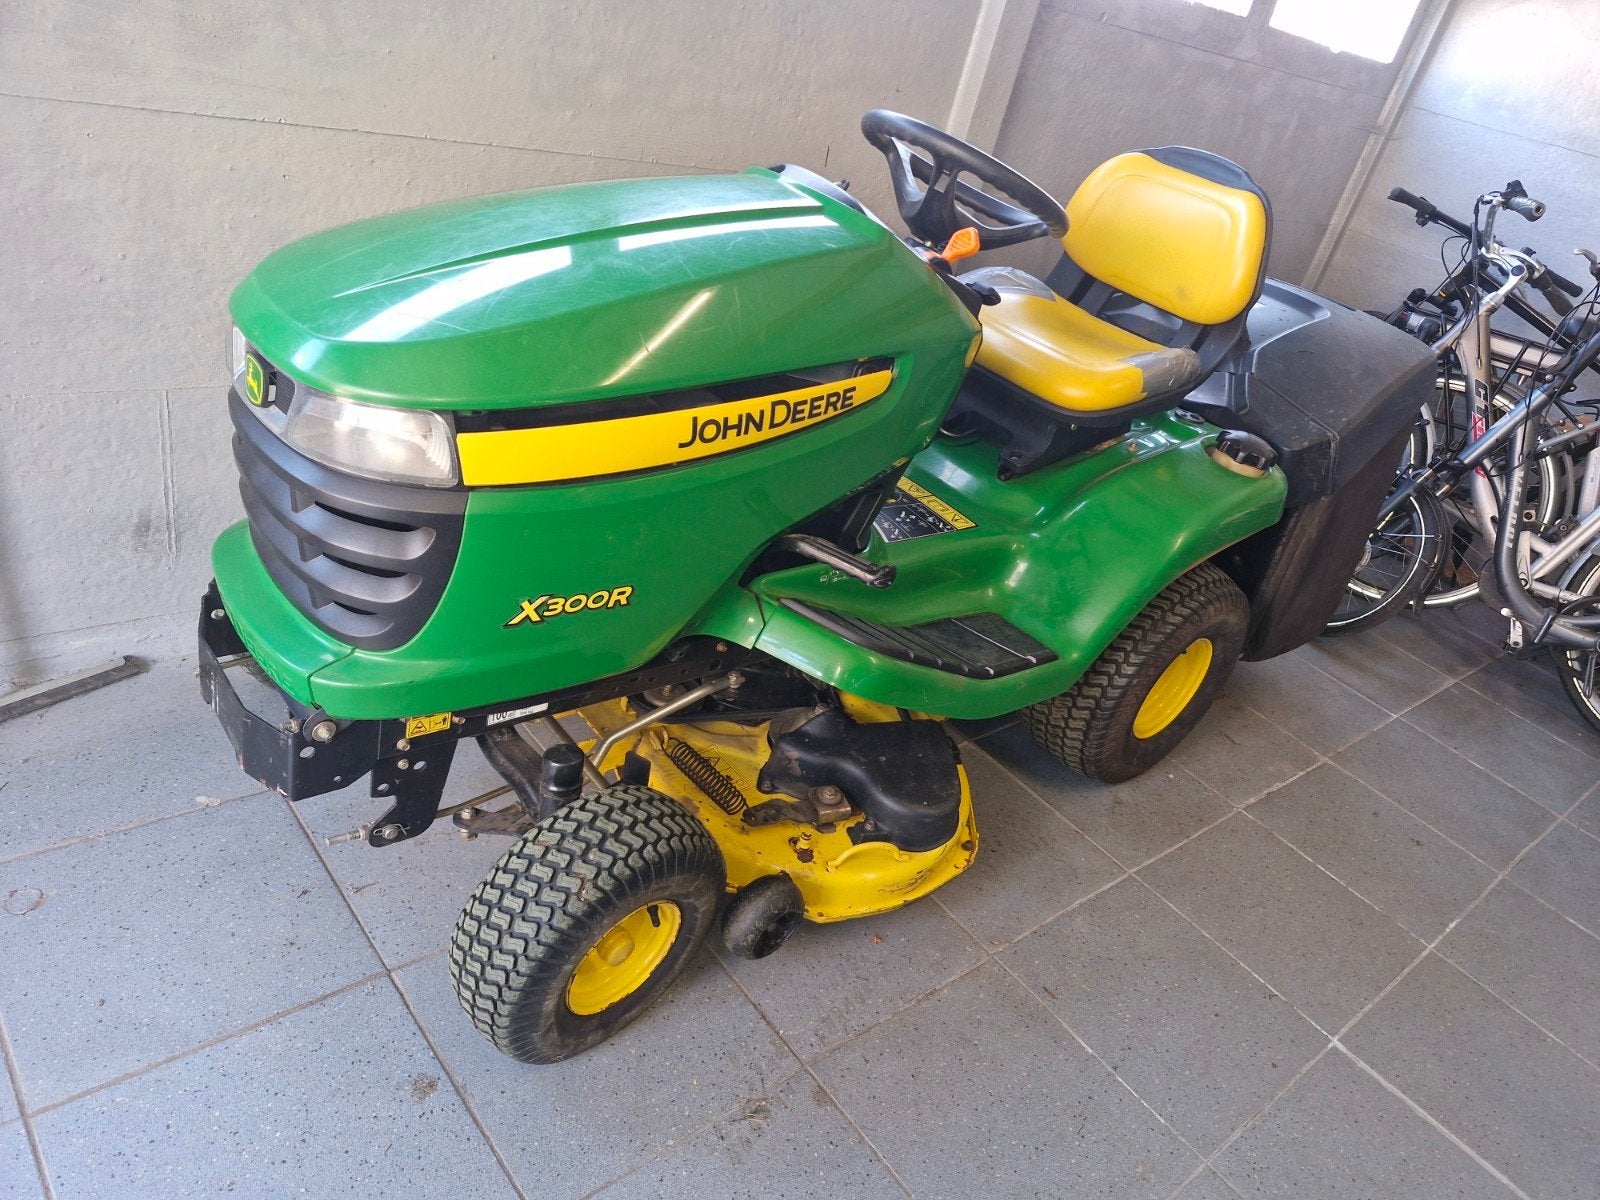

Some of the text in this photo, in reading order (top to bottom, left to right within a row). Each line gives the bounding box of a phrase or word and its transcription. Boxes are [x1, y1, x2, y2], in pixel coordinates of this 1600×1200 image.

[678, 386, 857, 449] JOHN DEERE
[503, 586, 634, 629] X300R
